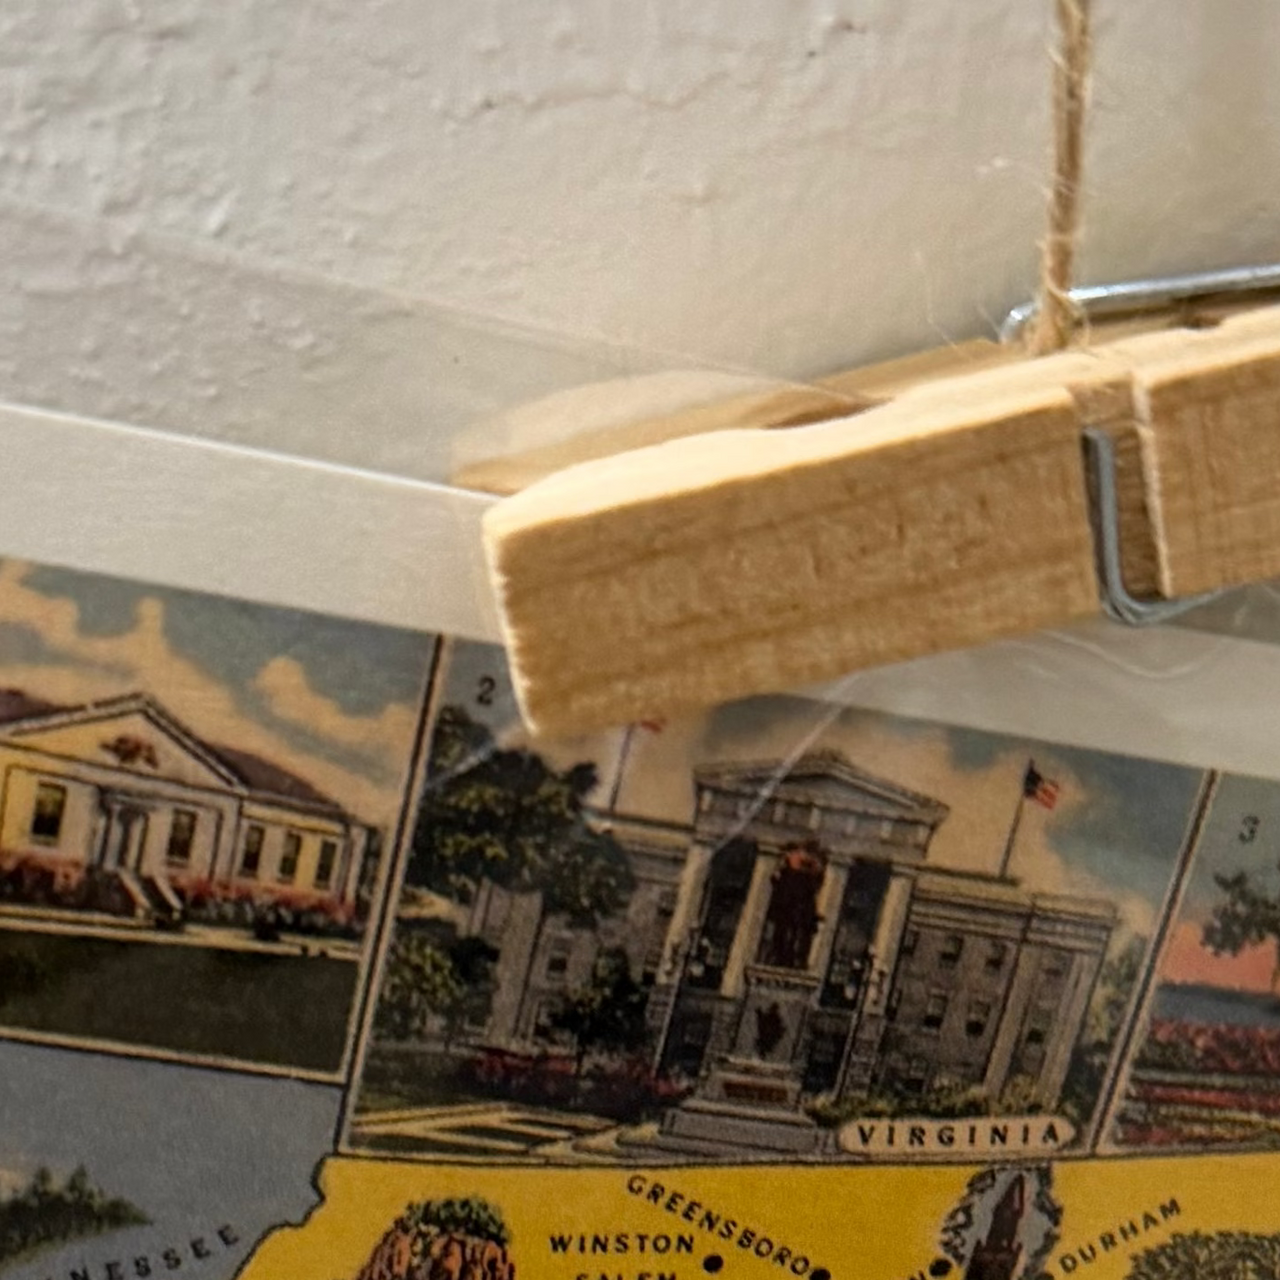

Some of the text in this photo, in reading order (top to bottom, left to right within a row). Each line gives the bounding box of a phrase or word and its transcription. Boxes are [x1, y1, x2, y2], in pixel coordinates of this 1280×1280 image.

[476, 676, 496, 705] 2
[1238, 816, 1261, 845] 3
[857, 1121, 1063, 1148] VIRGINIA
[626, 1173, 811, 1277] GREENSBORO
[1059, 1197, 1184, 1277] DURHAM
[549, 1233, 696, 1254] WINSTON
